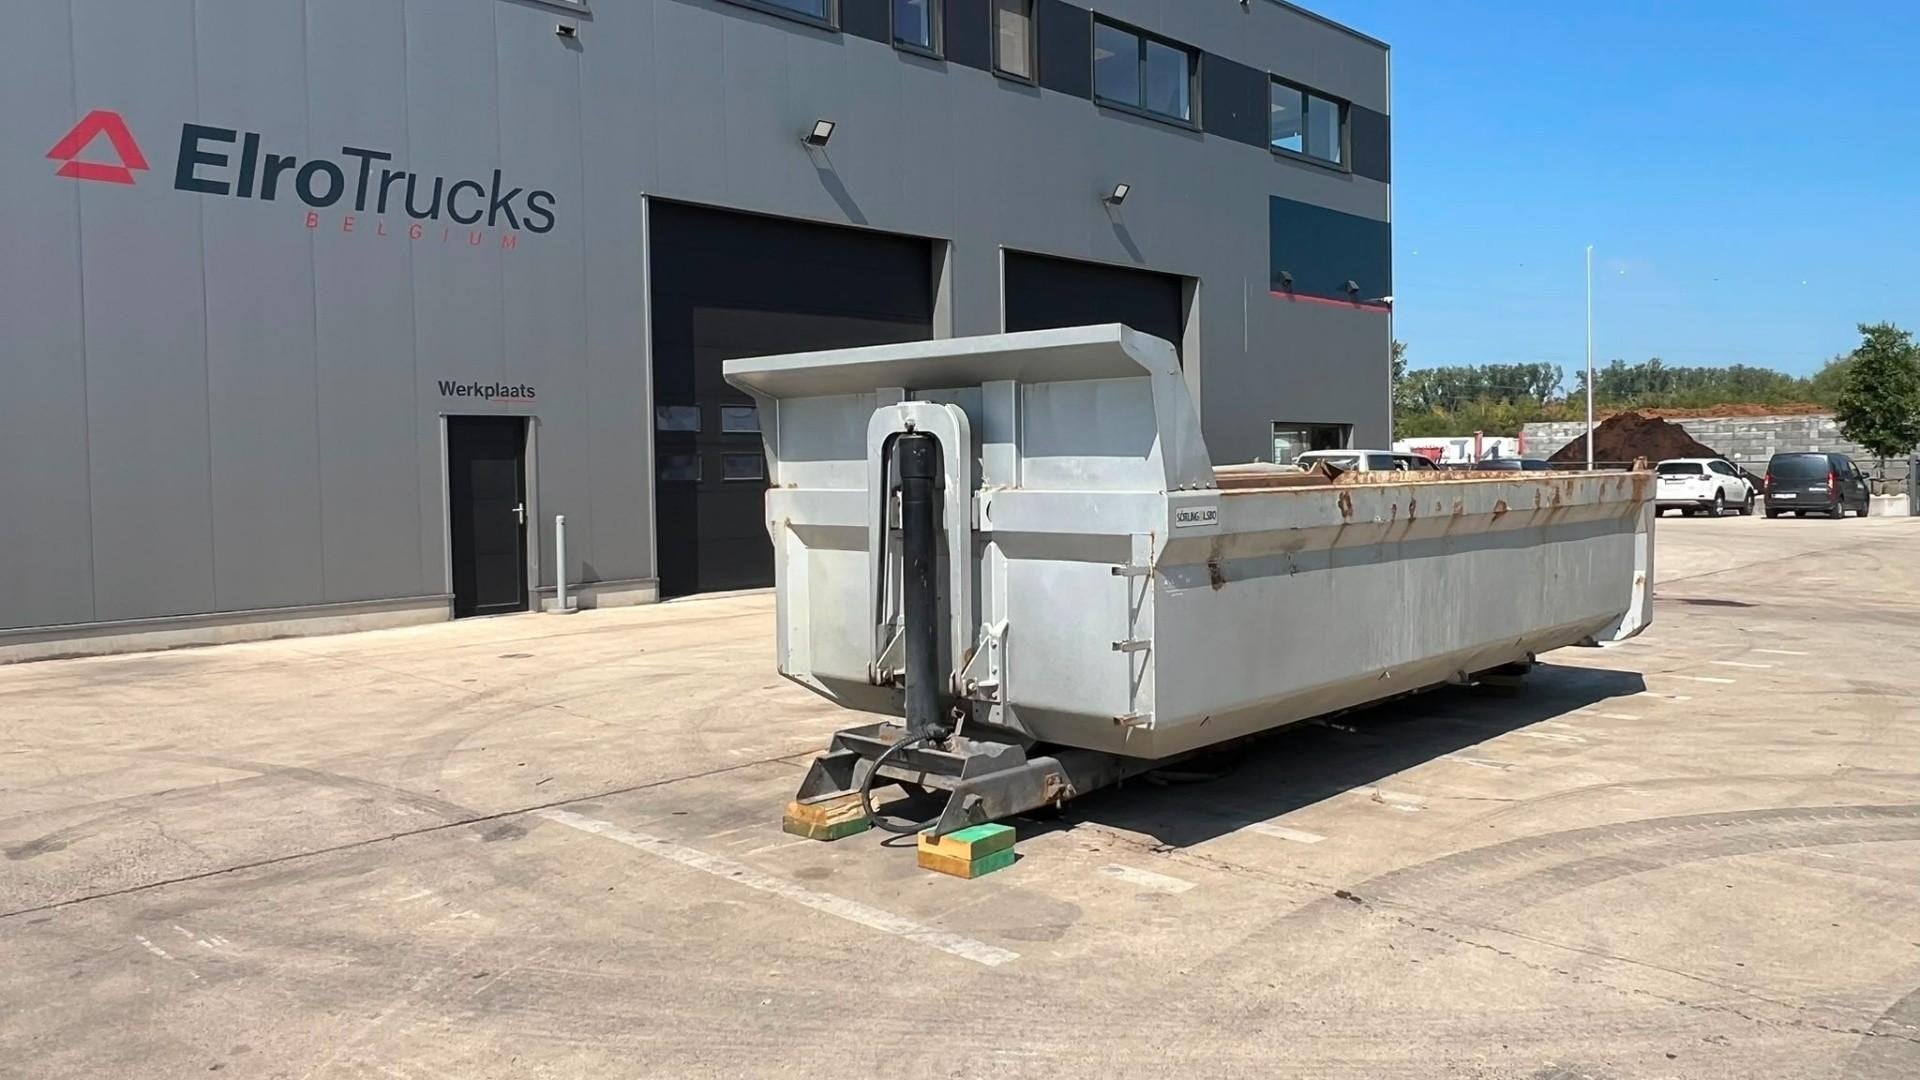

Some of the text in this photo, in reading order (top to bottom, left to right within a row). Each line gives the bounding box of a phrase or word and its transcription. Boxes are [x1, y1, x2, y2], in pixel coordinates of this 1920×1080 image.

[173, 122, 556, 234] ElroTrucks
[305, 211, 517, 250] BELGIUM
[438, 380, 536, 400] Werkplaats
